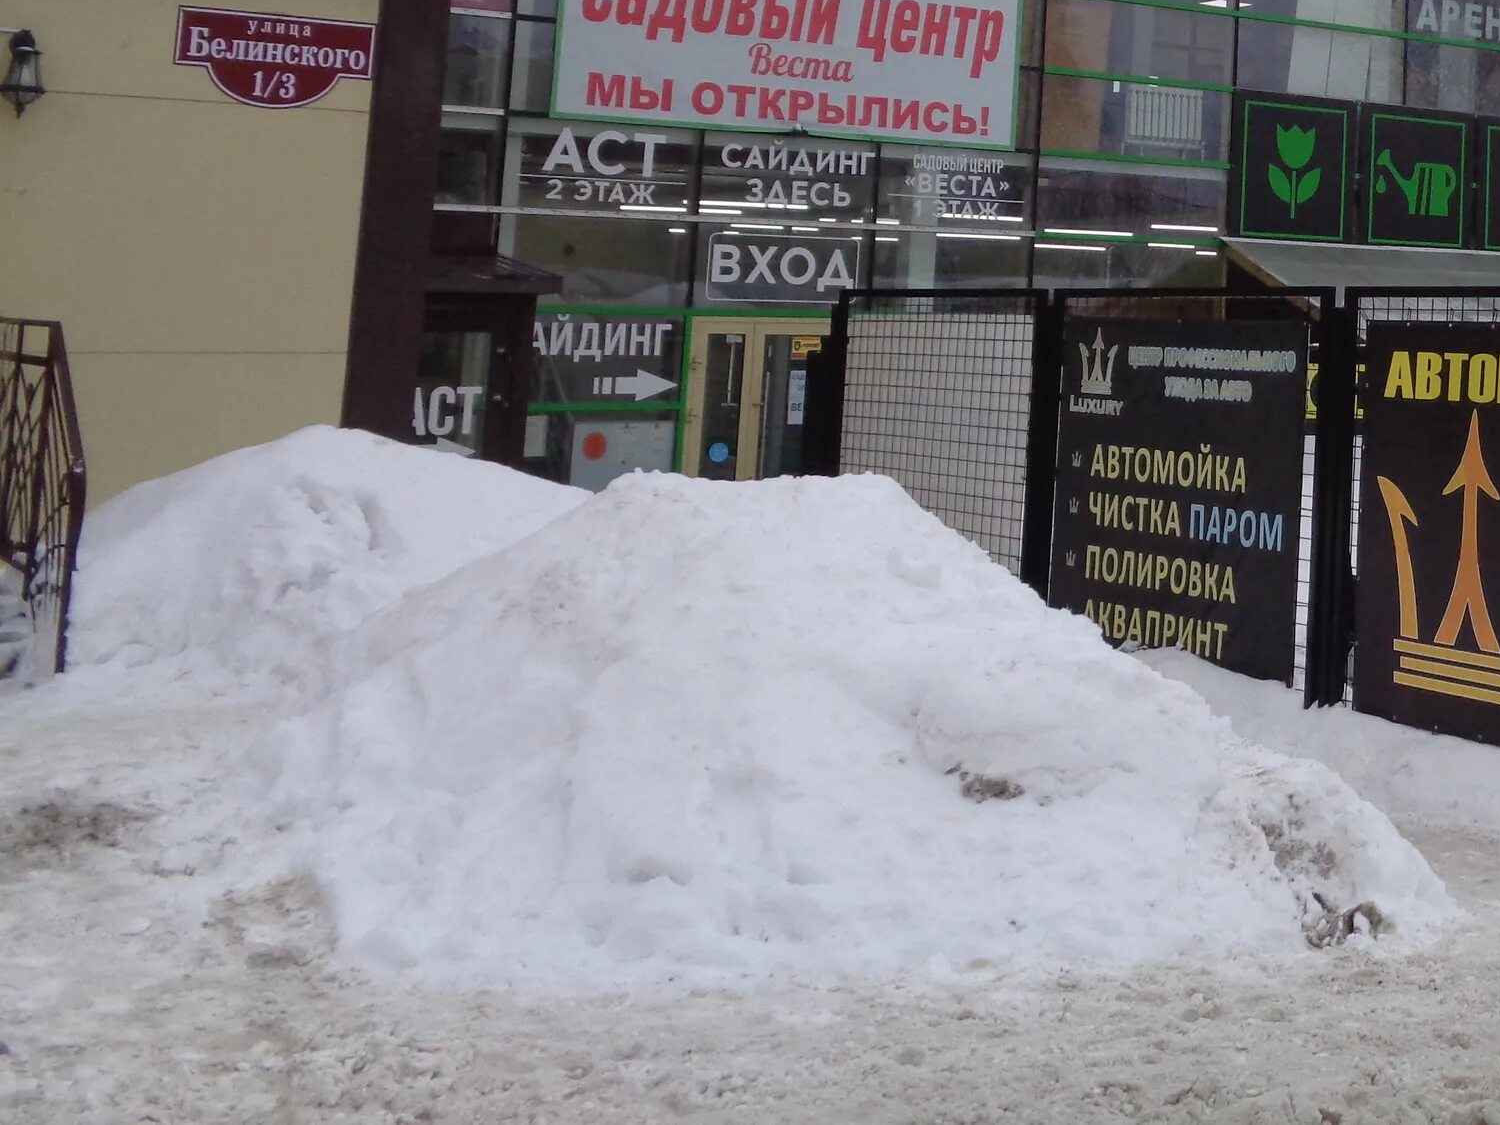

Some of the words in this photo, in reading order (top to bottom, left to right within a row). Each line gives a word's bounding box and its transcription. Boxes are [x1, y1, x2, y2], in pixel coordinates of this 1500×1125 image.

[186, 26, 366, 71] Белинского
[248, 18, 311, 37] улица
[748, 43, 854, 83] Веста
[252, 70, 296, 99] 1/3
[586, 72, 671, 111] МЫ
[691, 82, 990, 137] ОТКРЫЛИСЬ!
[542, 127, 667, 177] АСТ
[721, 139, 875, 176] САЙДИНГ
[913, 153, 968, 173] САДОВЫЙ
[970, 157, 1004, 175] ЦЕНТР
[545, 180, 563, 199] 2
[574, 180, 655, 204] ЭТАЖ
[745, 178, 851, 207] ЗДЕСЬ
[904, 173, 1010, 198] «ВЕСТА»
[934, 201, 1000, 220] ЭТАЖ
[711, 244, 854, 292] ВХОД
[532, 313, 672, 362] АЙДИНГ
[1090, 443, 1246, 493] АВТОМОЙКА
[1089, 492, 1181, 537] ЧИСТКА
[1189, 503, 1283, 552] ПАРОМ
[1085, 544, 1236, 604] ПОЛИРОВКА
[1084, 599, 1227, 660] АКВАПРИНТ
